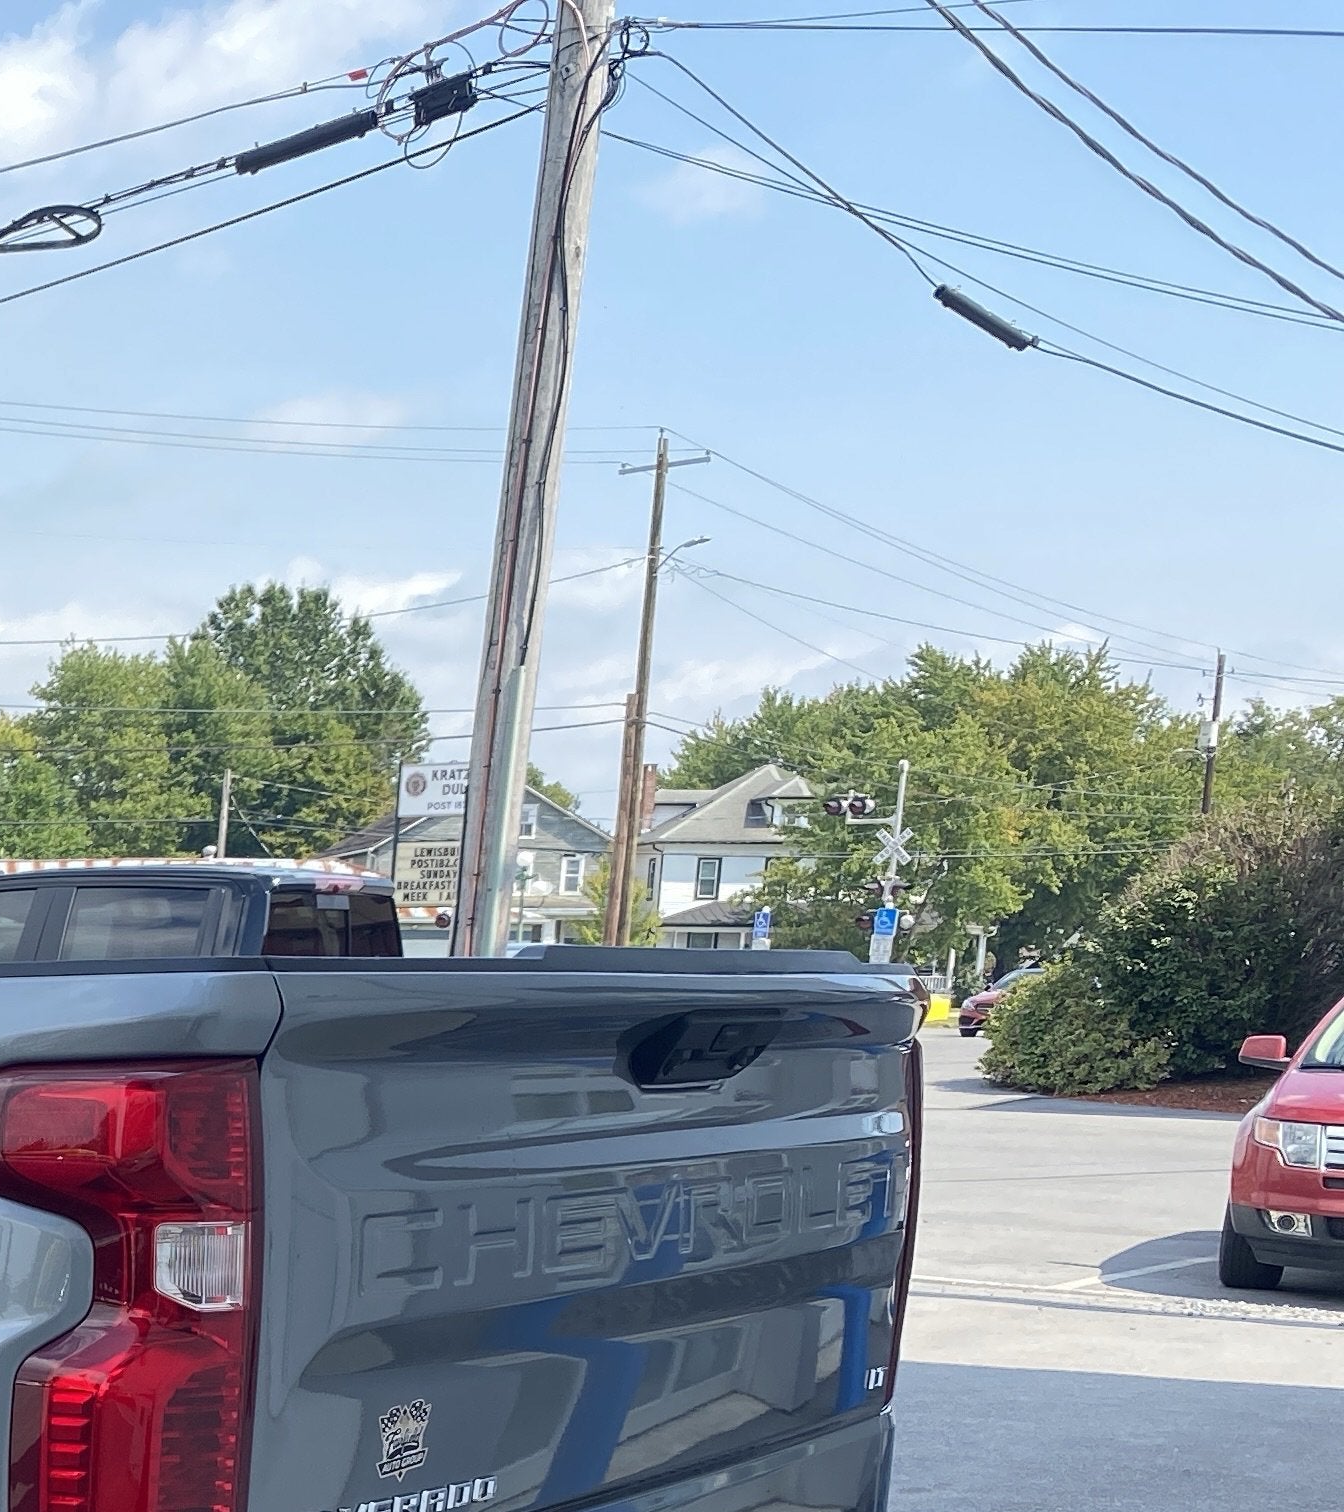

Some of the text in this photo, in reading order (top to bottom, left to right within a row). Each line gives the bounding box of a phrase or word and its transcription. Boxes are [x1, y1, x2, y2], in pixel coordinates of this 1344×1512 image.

[427, 802, 452, 811] POST
[420, 870, 458, 879] SUNDAY
[403, 892, 428, 901] WEEK
[359, 1153, 910, 1298] CHEVROLET
[381, 1460, 401, 1473] AUTO
